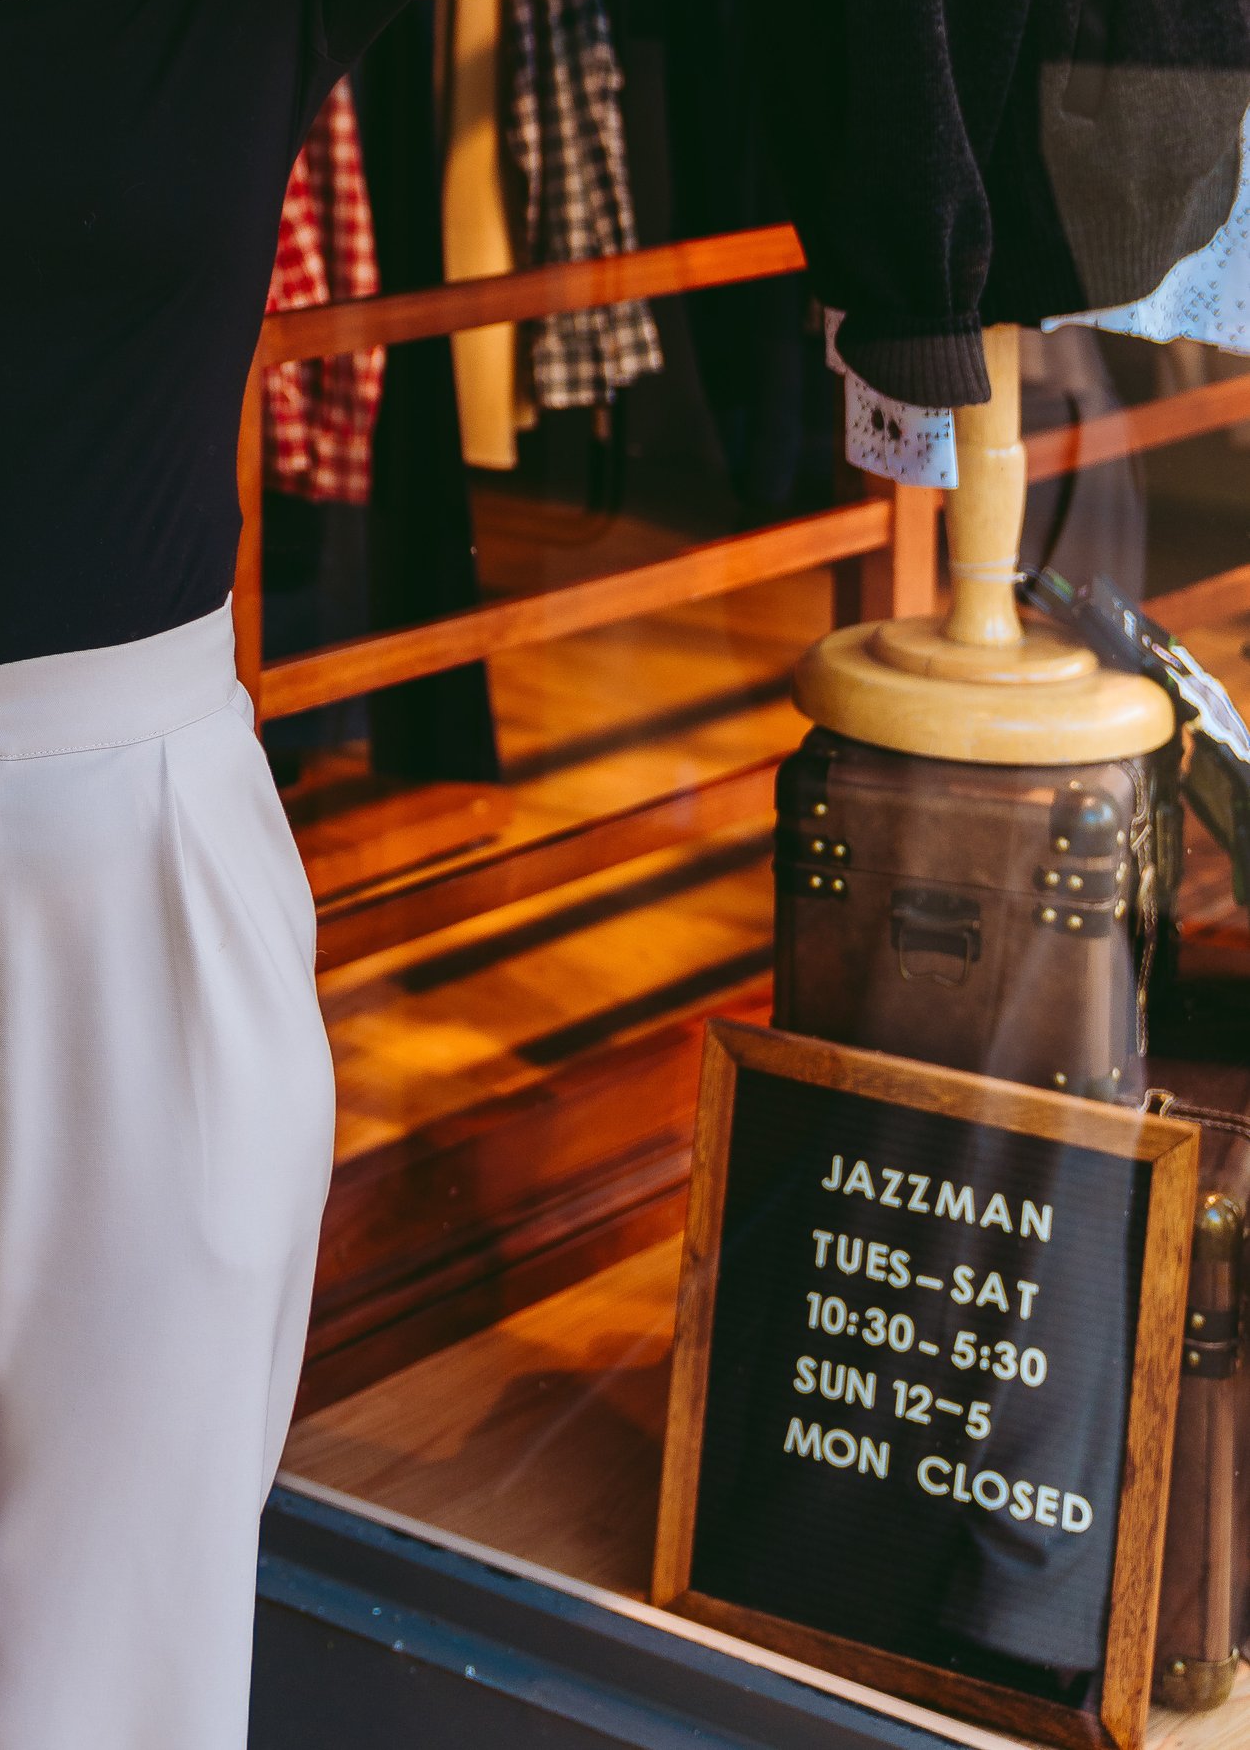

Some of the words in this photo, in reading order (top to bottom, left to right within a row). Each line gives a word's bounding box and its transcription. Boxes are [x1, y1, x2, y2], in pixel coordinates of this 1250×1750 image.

[821, 1154, 1053, 1243] JAZZMAN
[792, 1355, 877, 1410] SUN
[783, 1416, 890, 1479] MON
[916, 1455, 1094, 1534] CLOSED
